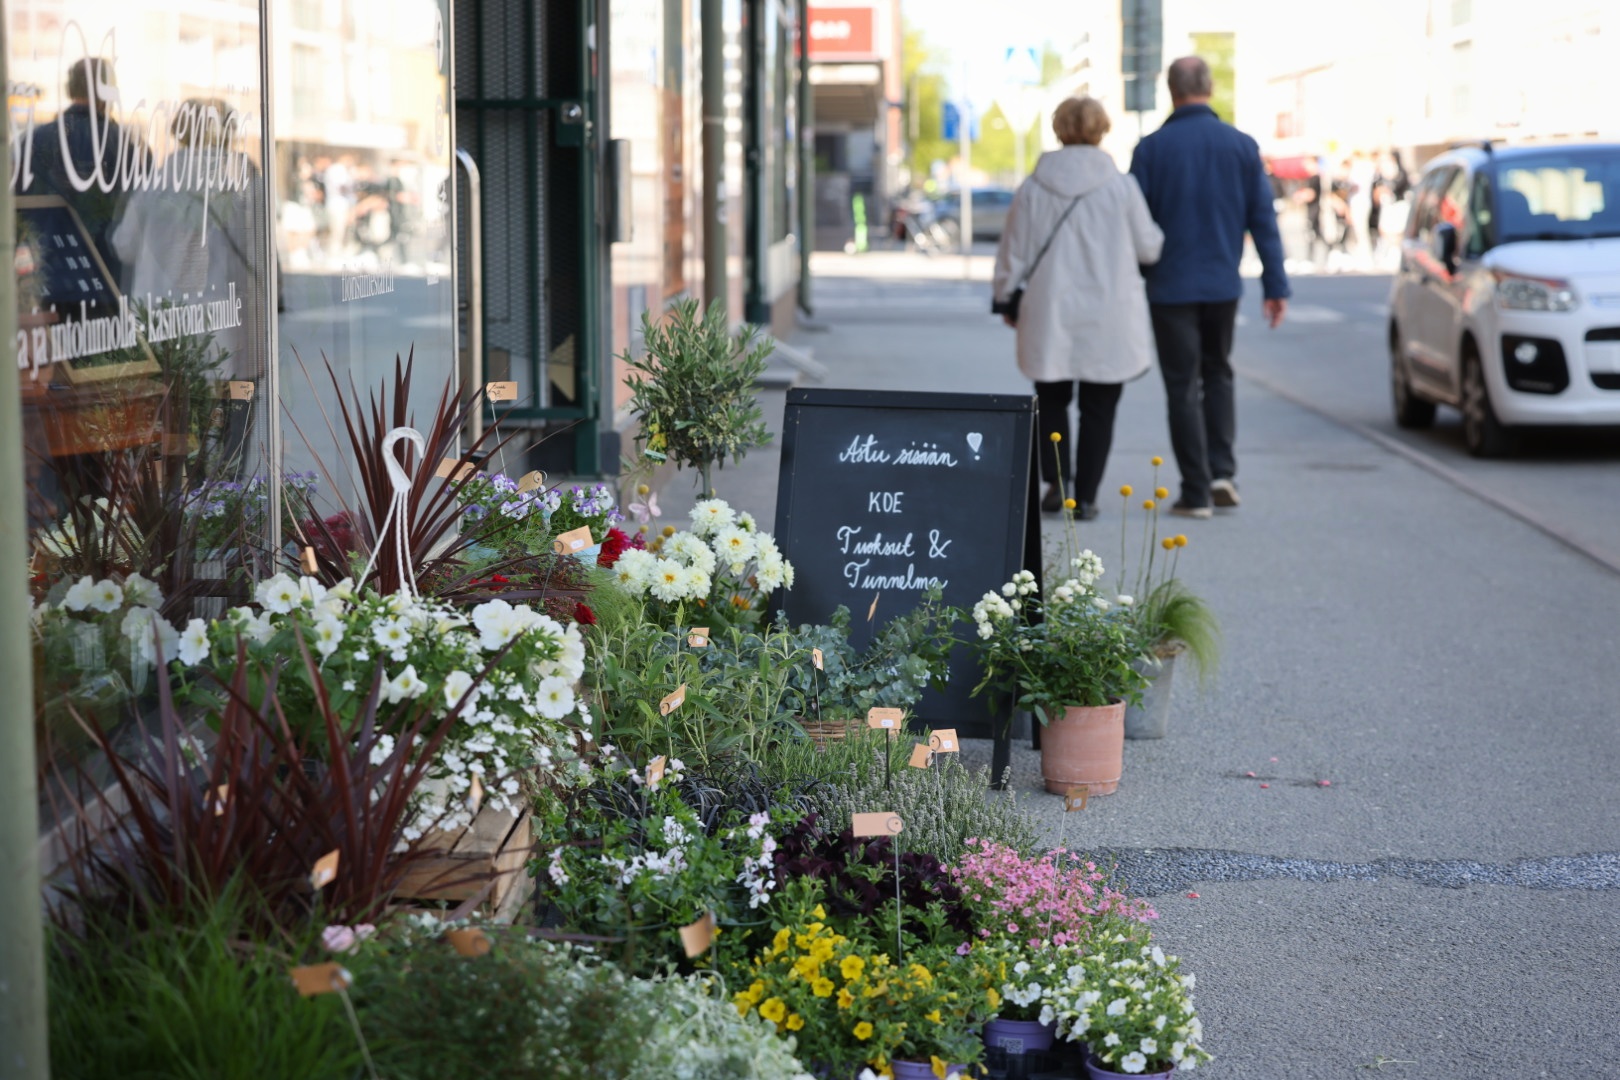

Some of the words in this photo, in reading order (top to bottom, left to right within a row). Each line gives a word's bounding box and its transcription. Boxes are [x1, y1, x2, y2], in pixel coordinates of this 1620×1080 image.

[51, 295, 137, 363] intohimolla
[147, 292, 204, 349] käsityönä
[207, 281, 242, 331] sinulle
[839, 433, 891, 463] Astu
[892, 440, 958, 467] sisään
[868, 491, 904, 513] KOE
[837, 525, 915, 557] Tuoksut
[929, 529, 952, 558] &
